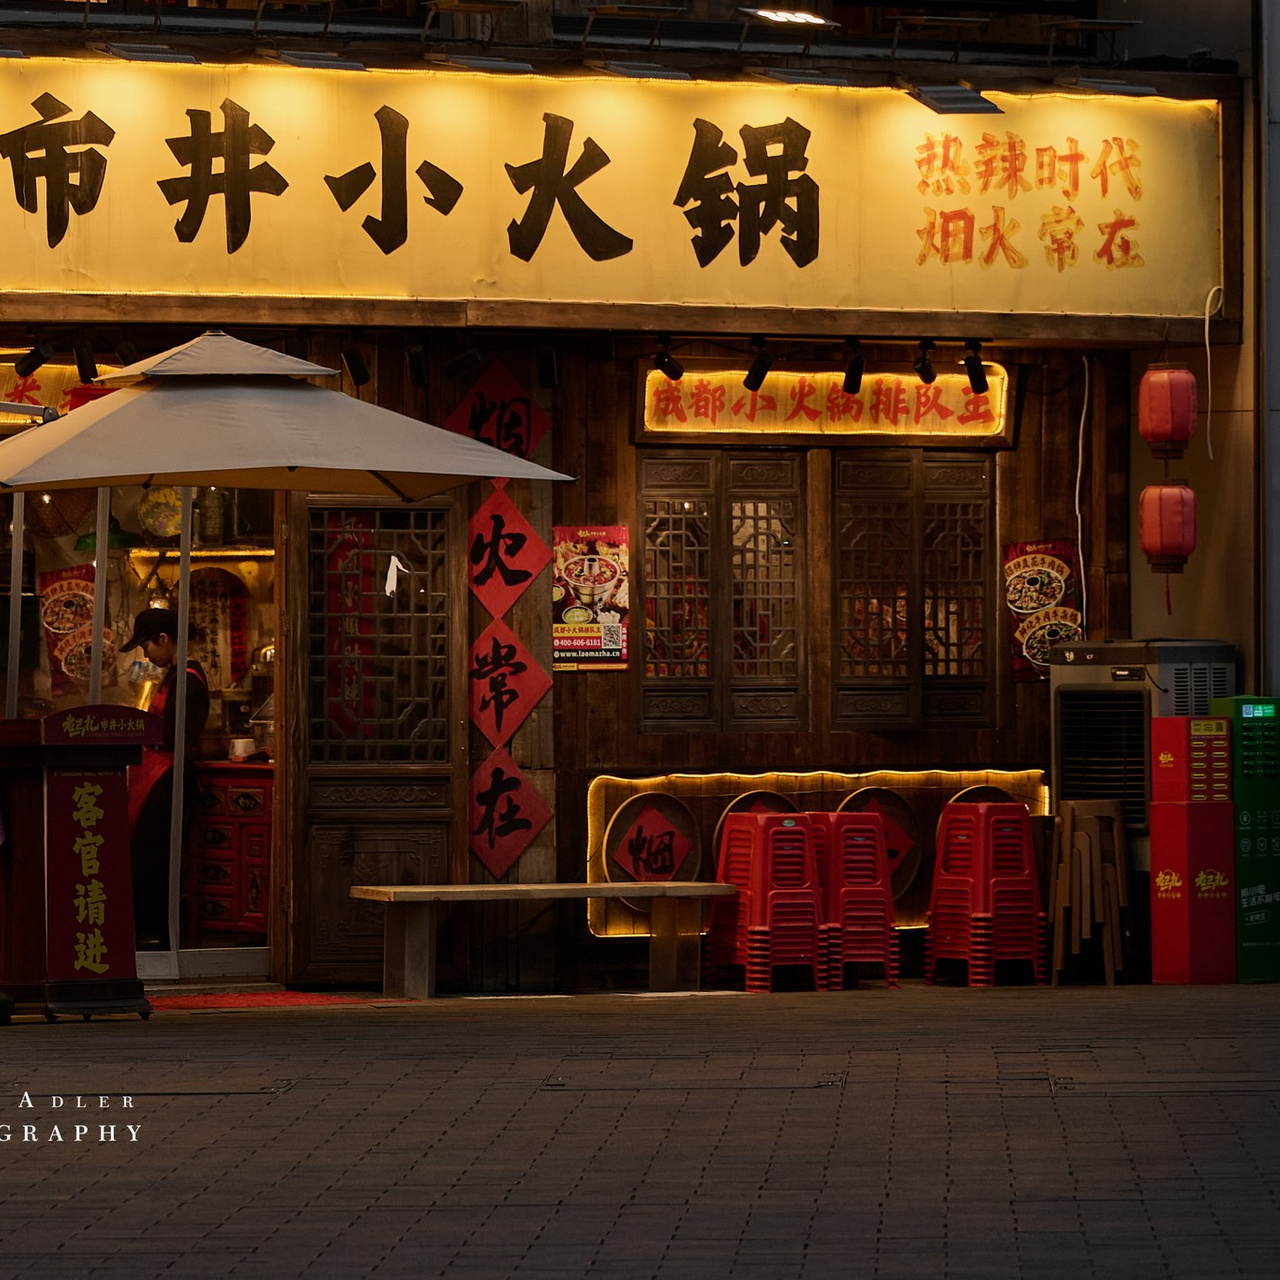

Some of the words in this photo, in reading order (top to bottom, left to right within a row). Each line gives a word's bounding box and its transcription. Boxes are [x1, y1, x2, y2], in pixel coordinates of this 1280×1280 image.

[914, 130, 1147, 203] 热辣时代
[914, 206, 1147, 274] 烟火常在
[652, 376, 997, 424] 成都小火锅排队王
[560, 650, 620, 658] www.laomazha.cn
[71, 781, 111, 974] 客官请进
